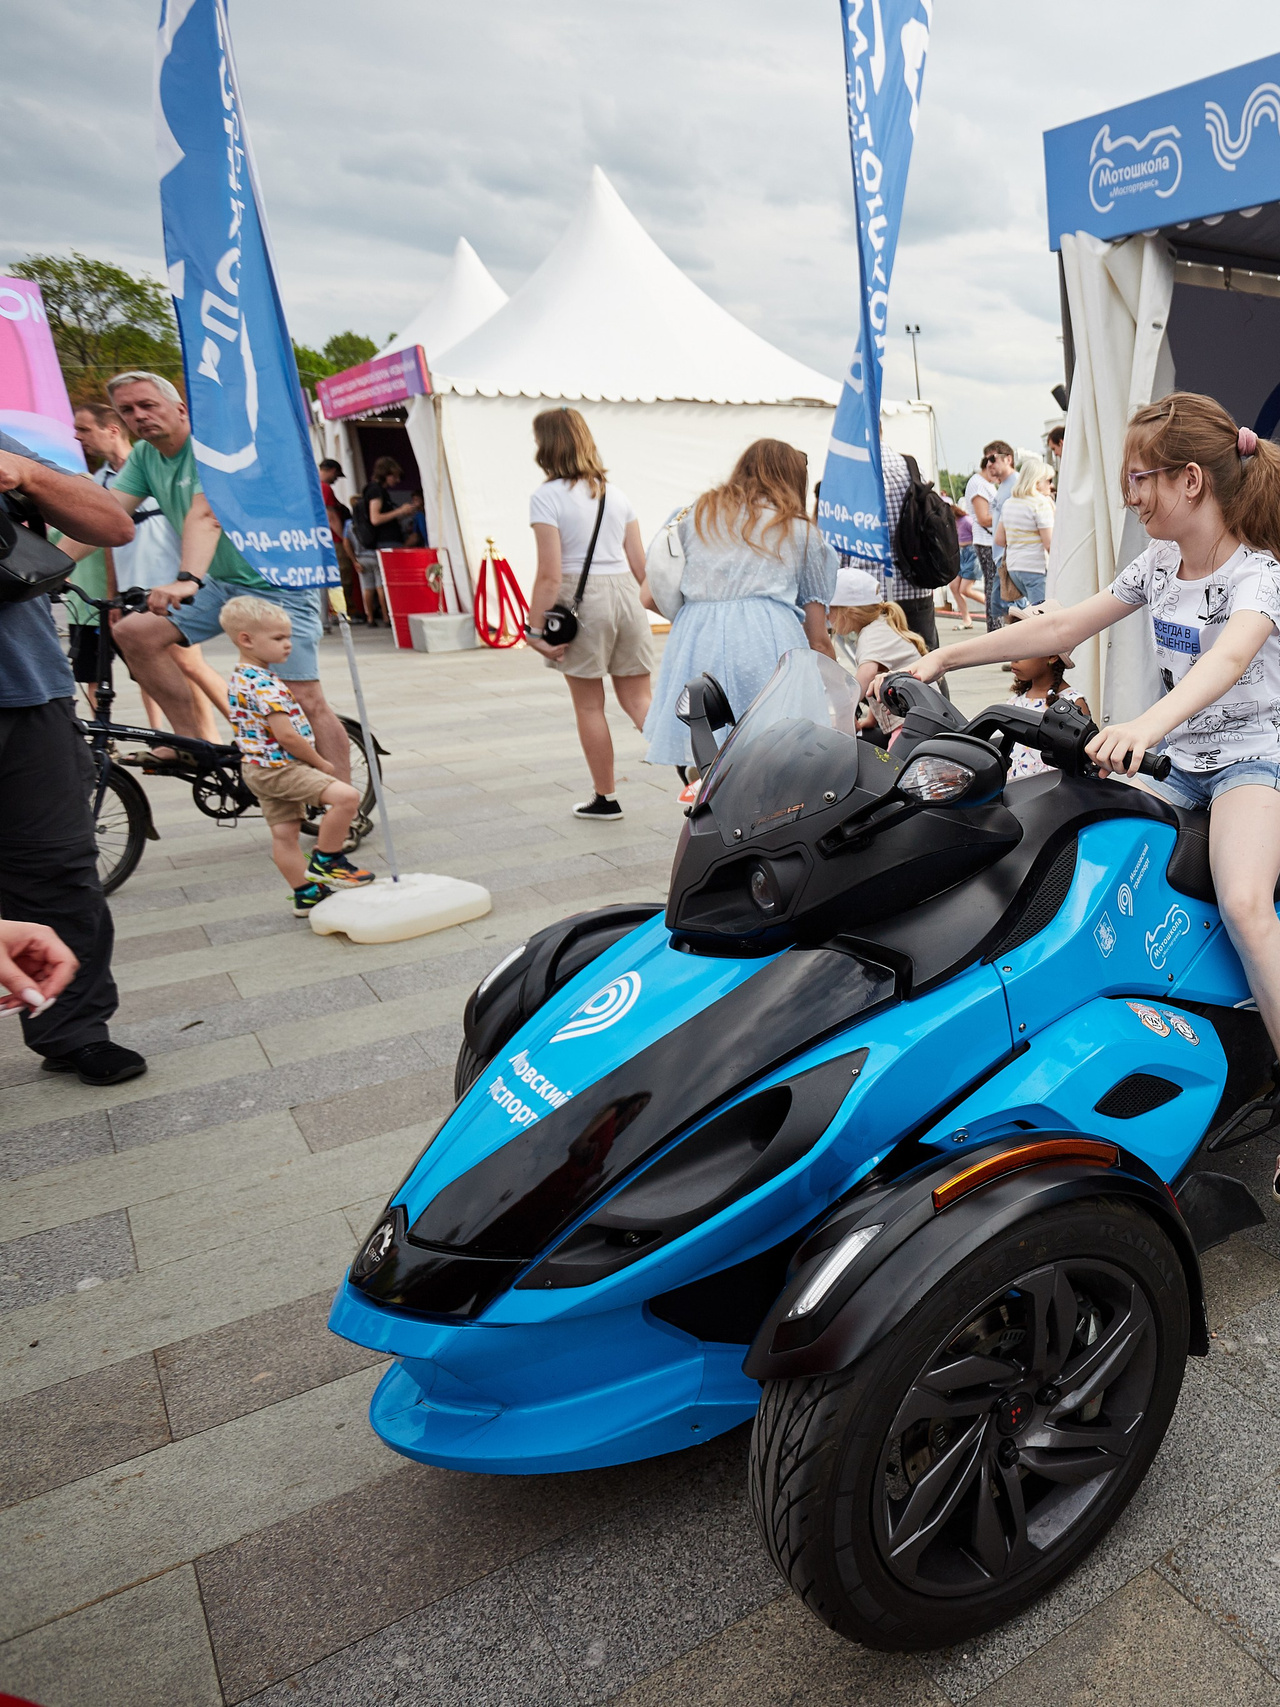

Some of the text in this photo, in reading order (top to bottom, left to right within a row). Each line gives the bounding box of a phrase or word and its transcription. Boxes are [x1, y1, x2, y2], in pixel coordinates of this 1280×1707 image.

[1098, 155, 1170, 188] Мотошкола
[1109, 178, 1159, 198] «Мосгортранс»
[1154, 620, 1192, 639] ВСЕГДА В
[1129, 843, 1150, 882] Московский
[1132, 857, 1150, 890] транспорт
[1153, 917, 1183, 960] Мотошкола
[368, 1247, 381, 1262] BRP
